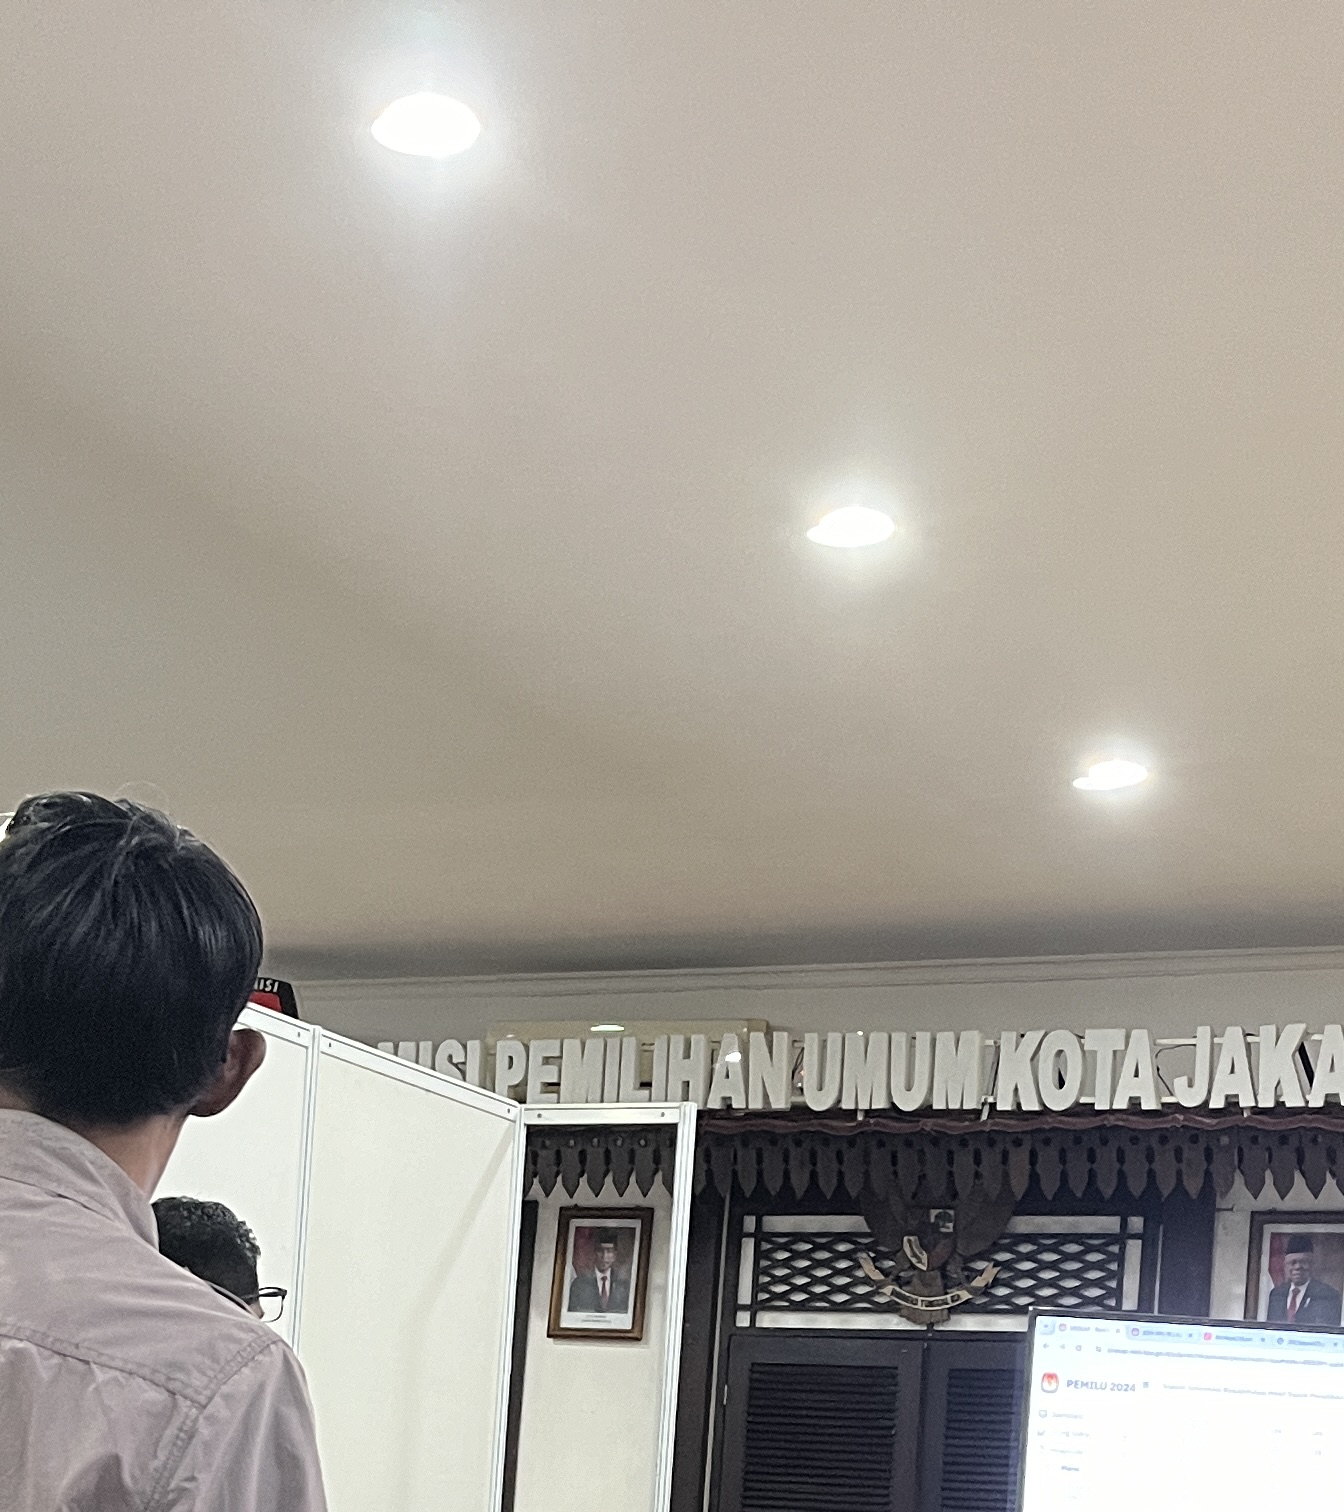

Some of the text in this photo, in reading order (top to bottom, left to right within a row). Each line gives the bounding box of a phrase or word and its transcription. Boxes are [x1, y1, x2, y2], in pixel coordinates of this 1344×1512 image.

[494, 1030, 792, 1111] PEMILIHAN
[803, 1030, 984, 1112] UMUM
[996, 1028, 1163, 1112] KOTA
[1066, 1379, 1136, 1392] PEMILU 2024
